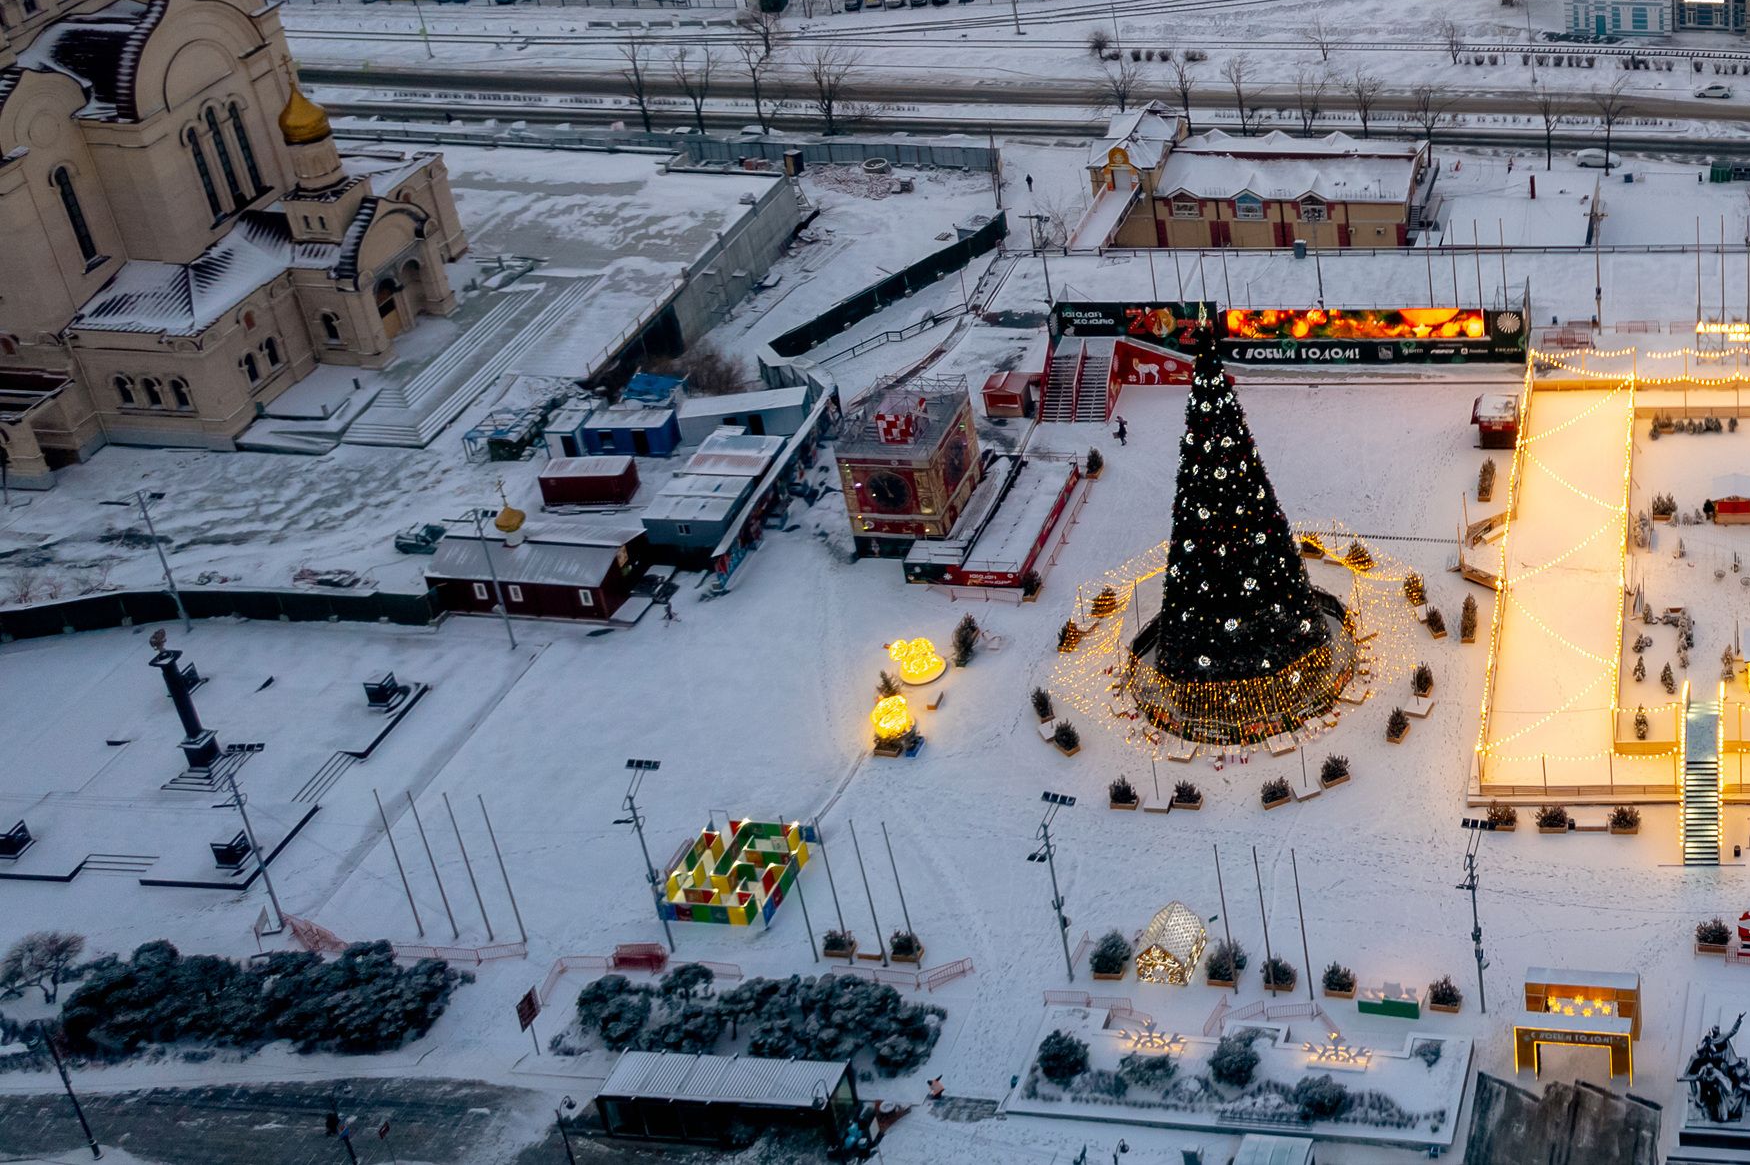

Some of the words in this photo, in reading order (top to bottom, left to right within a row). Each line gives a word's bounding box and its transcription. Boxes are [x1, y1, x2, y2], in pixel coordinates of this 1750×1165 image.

[1232, 348, 1240, 359] С
[1245, 348, 1296, 359] НОВЫМ
[1301, 348, 1360, 360] ГОДОМ!
